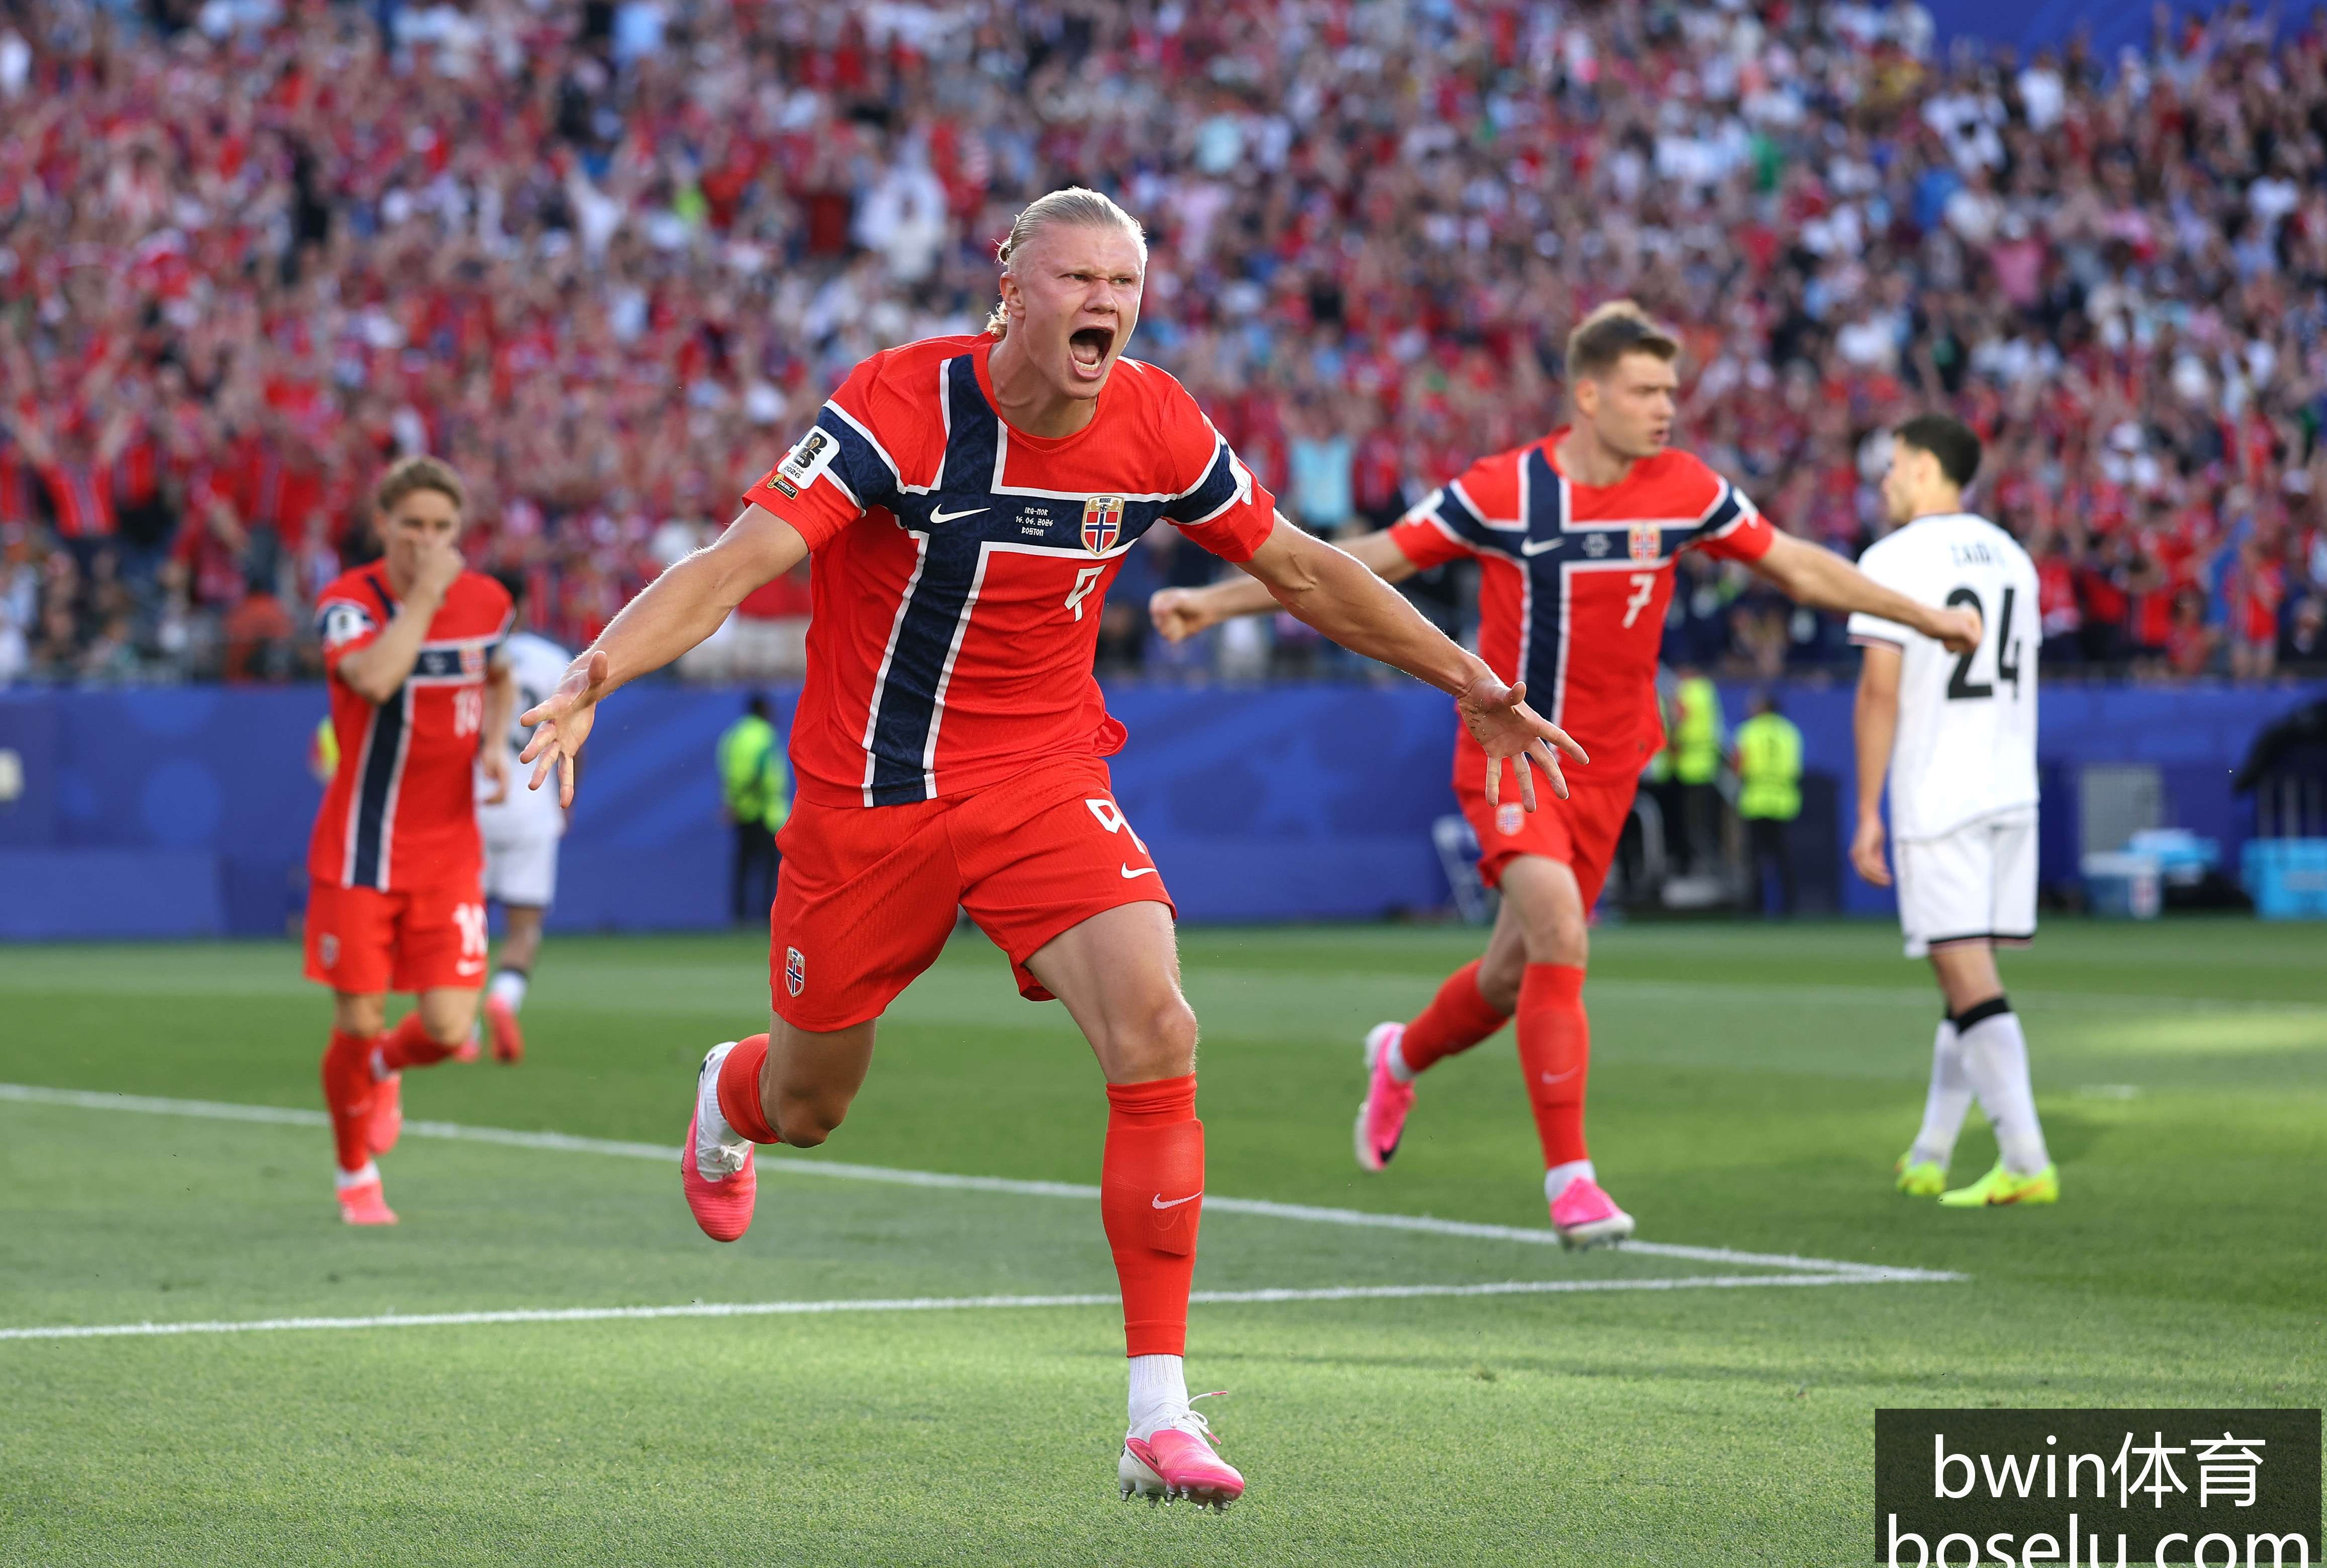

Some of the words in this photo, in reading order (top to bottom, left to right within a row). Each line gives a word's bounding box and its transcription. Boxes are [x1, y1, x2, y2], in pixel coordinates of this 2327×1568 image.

[778, 480, 796, 494] DEBUT
[784, 465, 801, 478] 2026
[1024, 507, 1049, 516] IRQ-NOR
[1021, 526, 1044, 537] BOSTON
[1064, 564, 1107, 622] 9
[1622, 573, 1656, 629] 7
[1944, 585, 2021, 702] 24
[1084, 799, 1147, 855] 9
